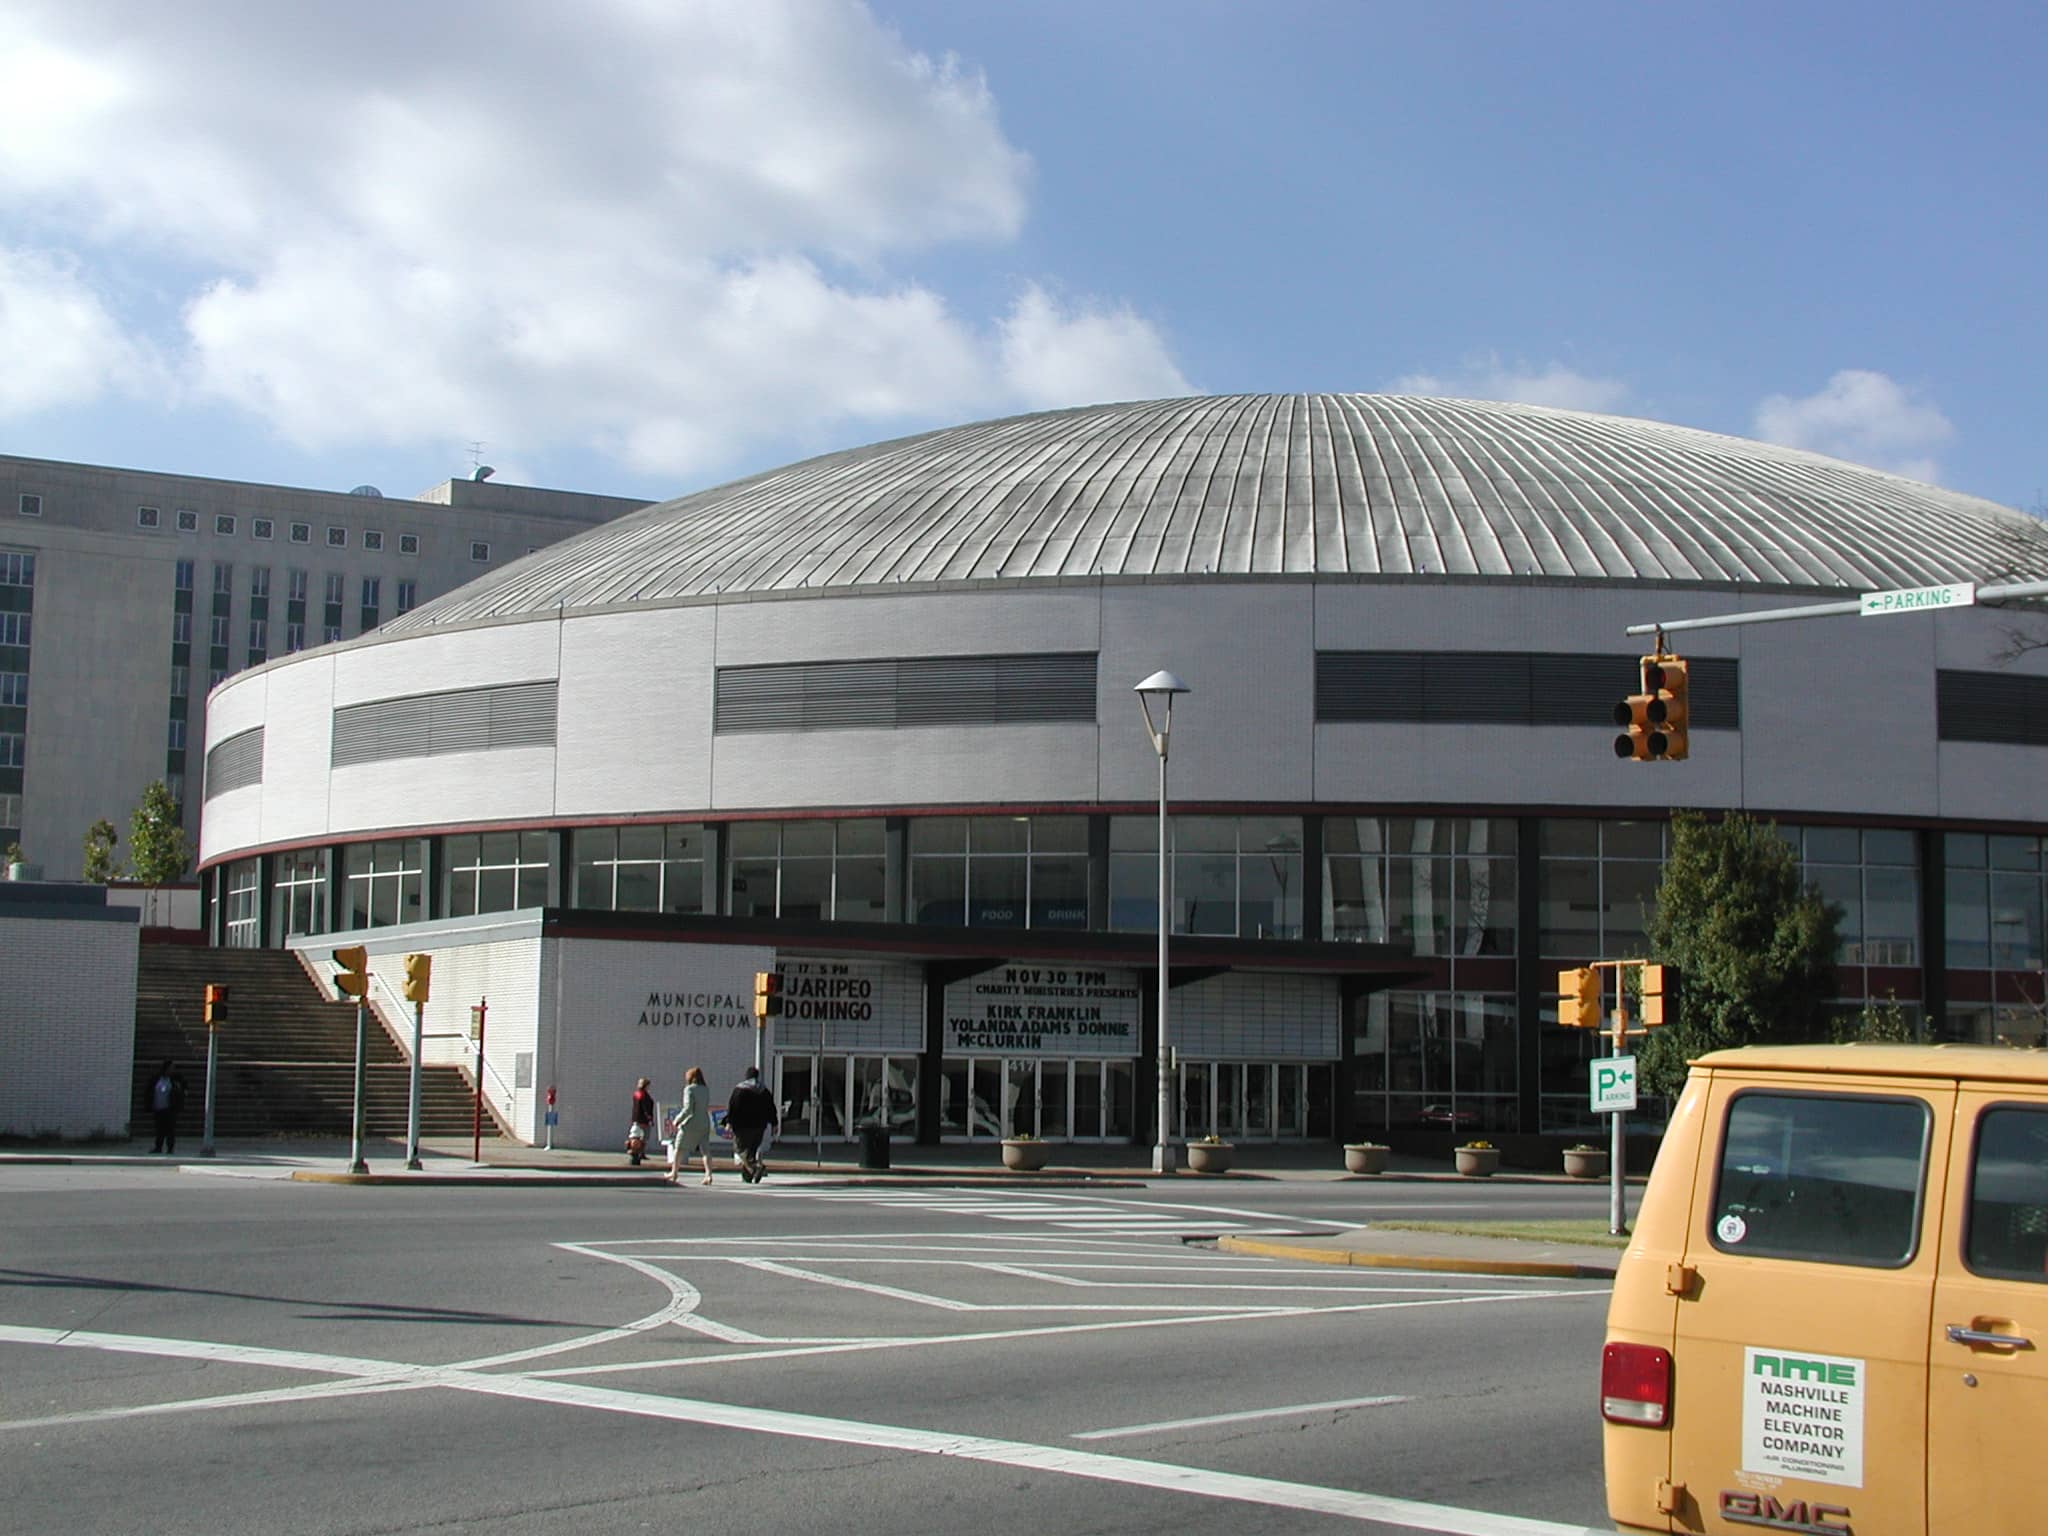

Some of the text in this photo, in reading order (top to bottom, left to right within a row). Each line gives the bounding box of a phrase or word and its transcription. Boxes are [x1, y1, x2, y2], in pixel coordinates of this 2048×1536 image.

[1884, 589, 1951, 610] PARKING
[982, 910, 1013, 920] FOOD
[832, 964, 849, 975] PM
[1006, 969, 1106, 985] NOV 30 7PM
[786, 978, 872, 998] JARIPEO
[976, 984, 1139, 998] CHARITY MINISTRIES PRESENTS
[647, 992, 745, 1009] MUNICIPAL
[785, 999, 872, 1020] DOMINGO
[987, 1004, 1100, 1020] KIRK FRANKLIN
[638, 1011, 752, 1028] AUDITORIUM
[950, 1018, 1129, 1036] YOLANDA ADAMS DONNIE
[1008, 1060, 1035, 1072] 417
[1761, 1382, 1849, 1404] NASHVILLE
[1766, 1400, 1842, 1422] MACHINE
[1764, 1418, 1844, 1440] ELEVATOR
[1763, 1436, 1845, 1458] COMPANY
[1782, 1456, 1845, 1471] CONDITIONING
[1719, 1489, 1851, 1531] GMC
